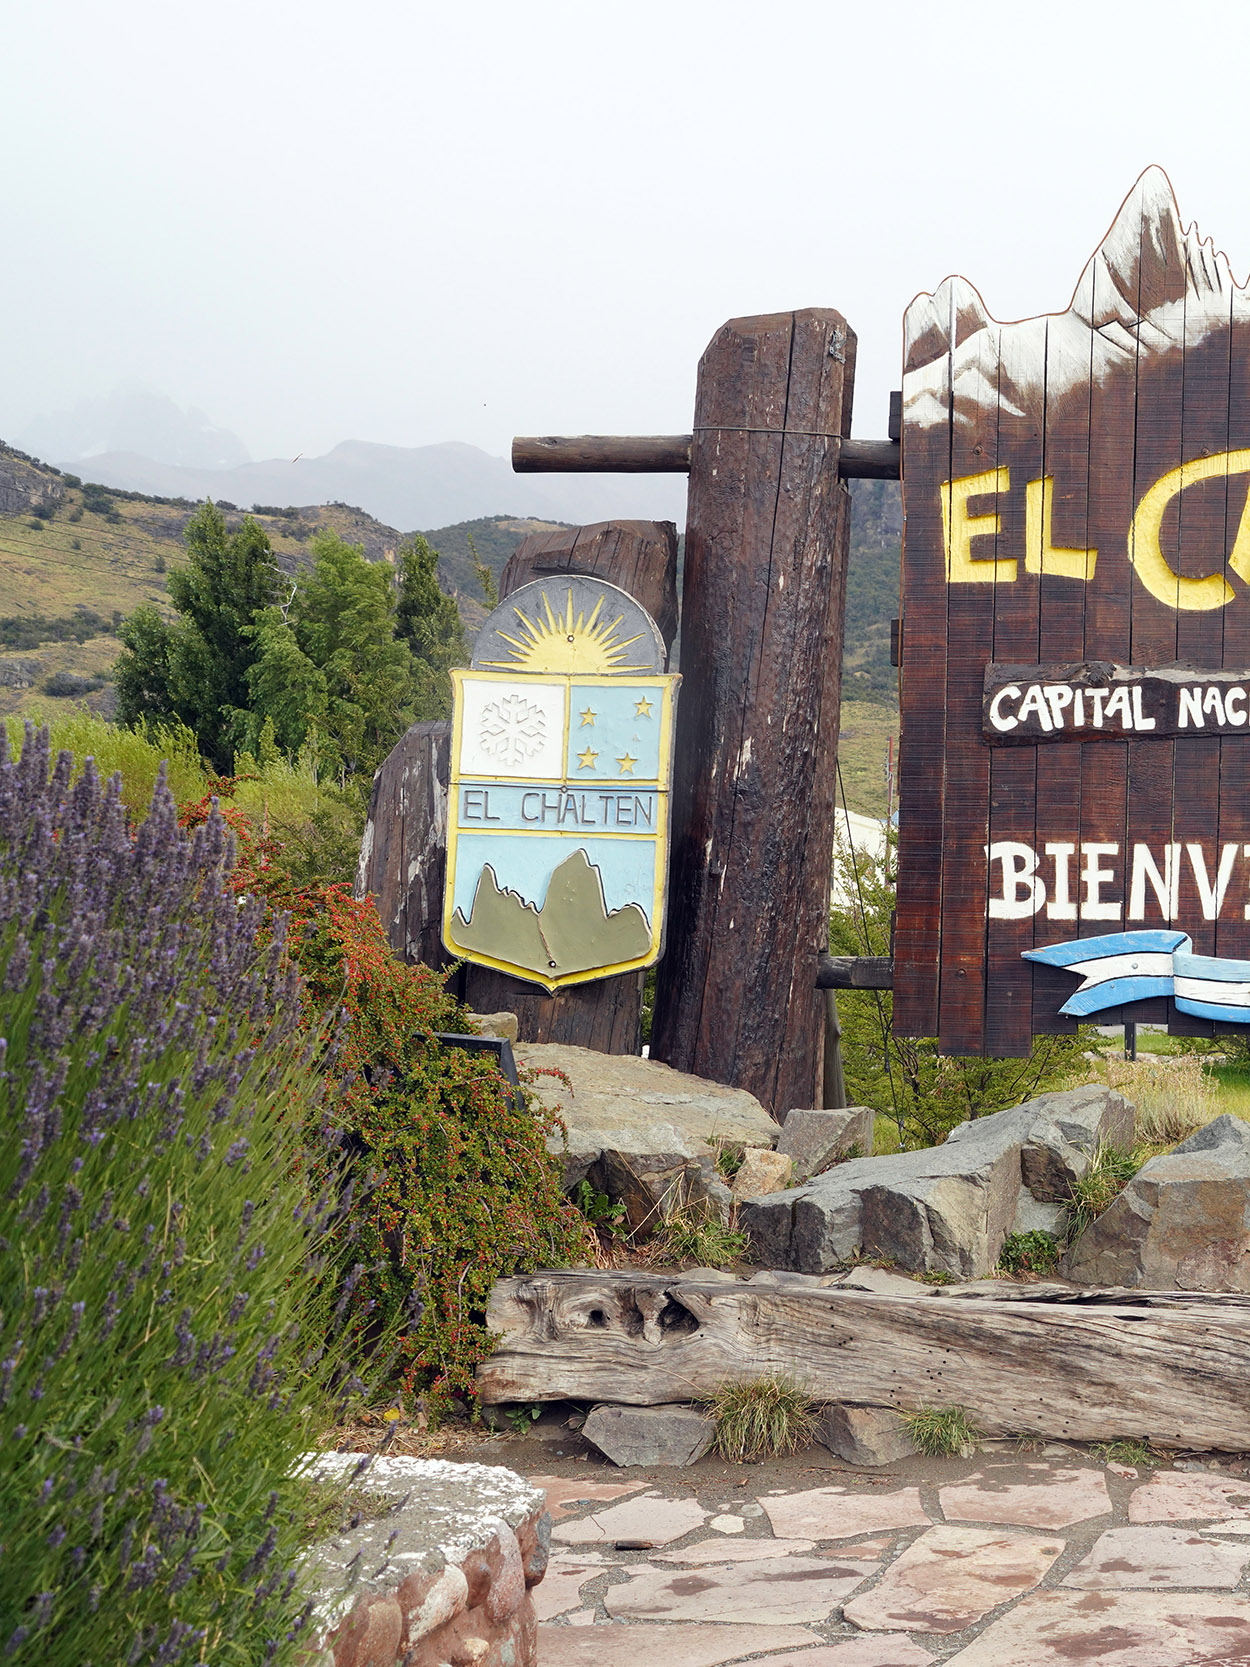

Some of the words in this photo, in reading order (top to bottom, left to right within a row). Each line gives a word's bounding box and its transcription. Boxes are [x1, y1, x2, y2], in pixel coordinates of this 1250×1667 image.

[940, 465, 1099, 584] EL
[989, 683, 1156, 733] CAPITAL
[464, 789, 501, 822] EL
[521, 791, 653, 827] CHALTEN
